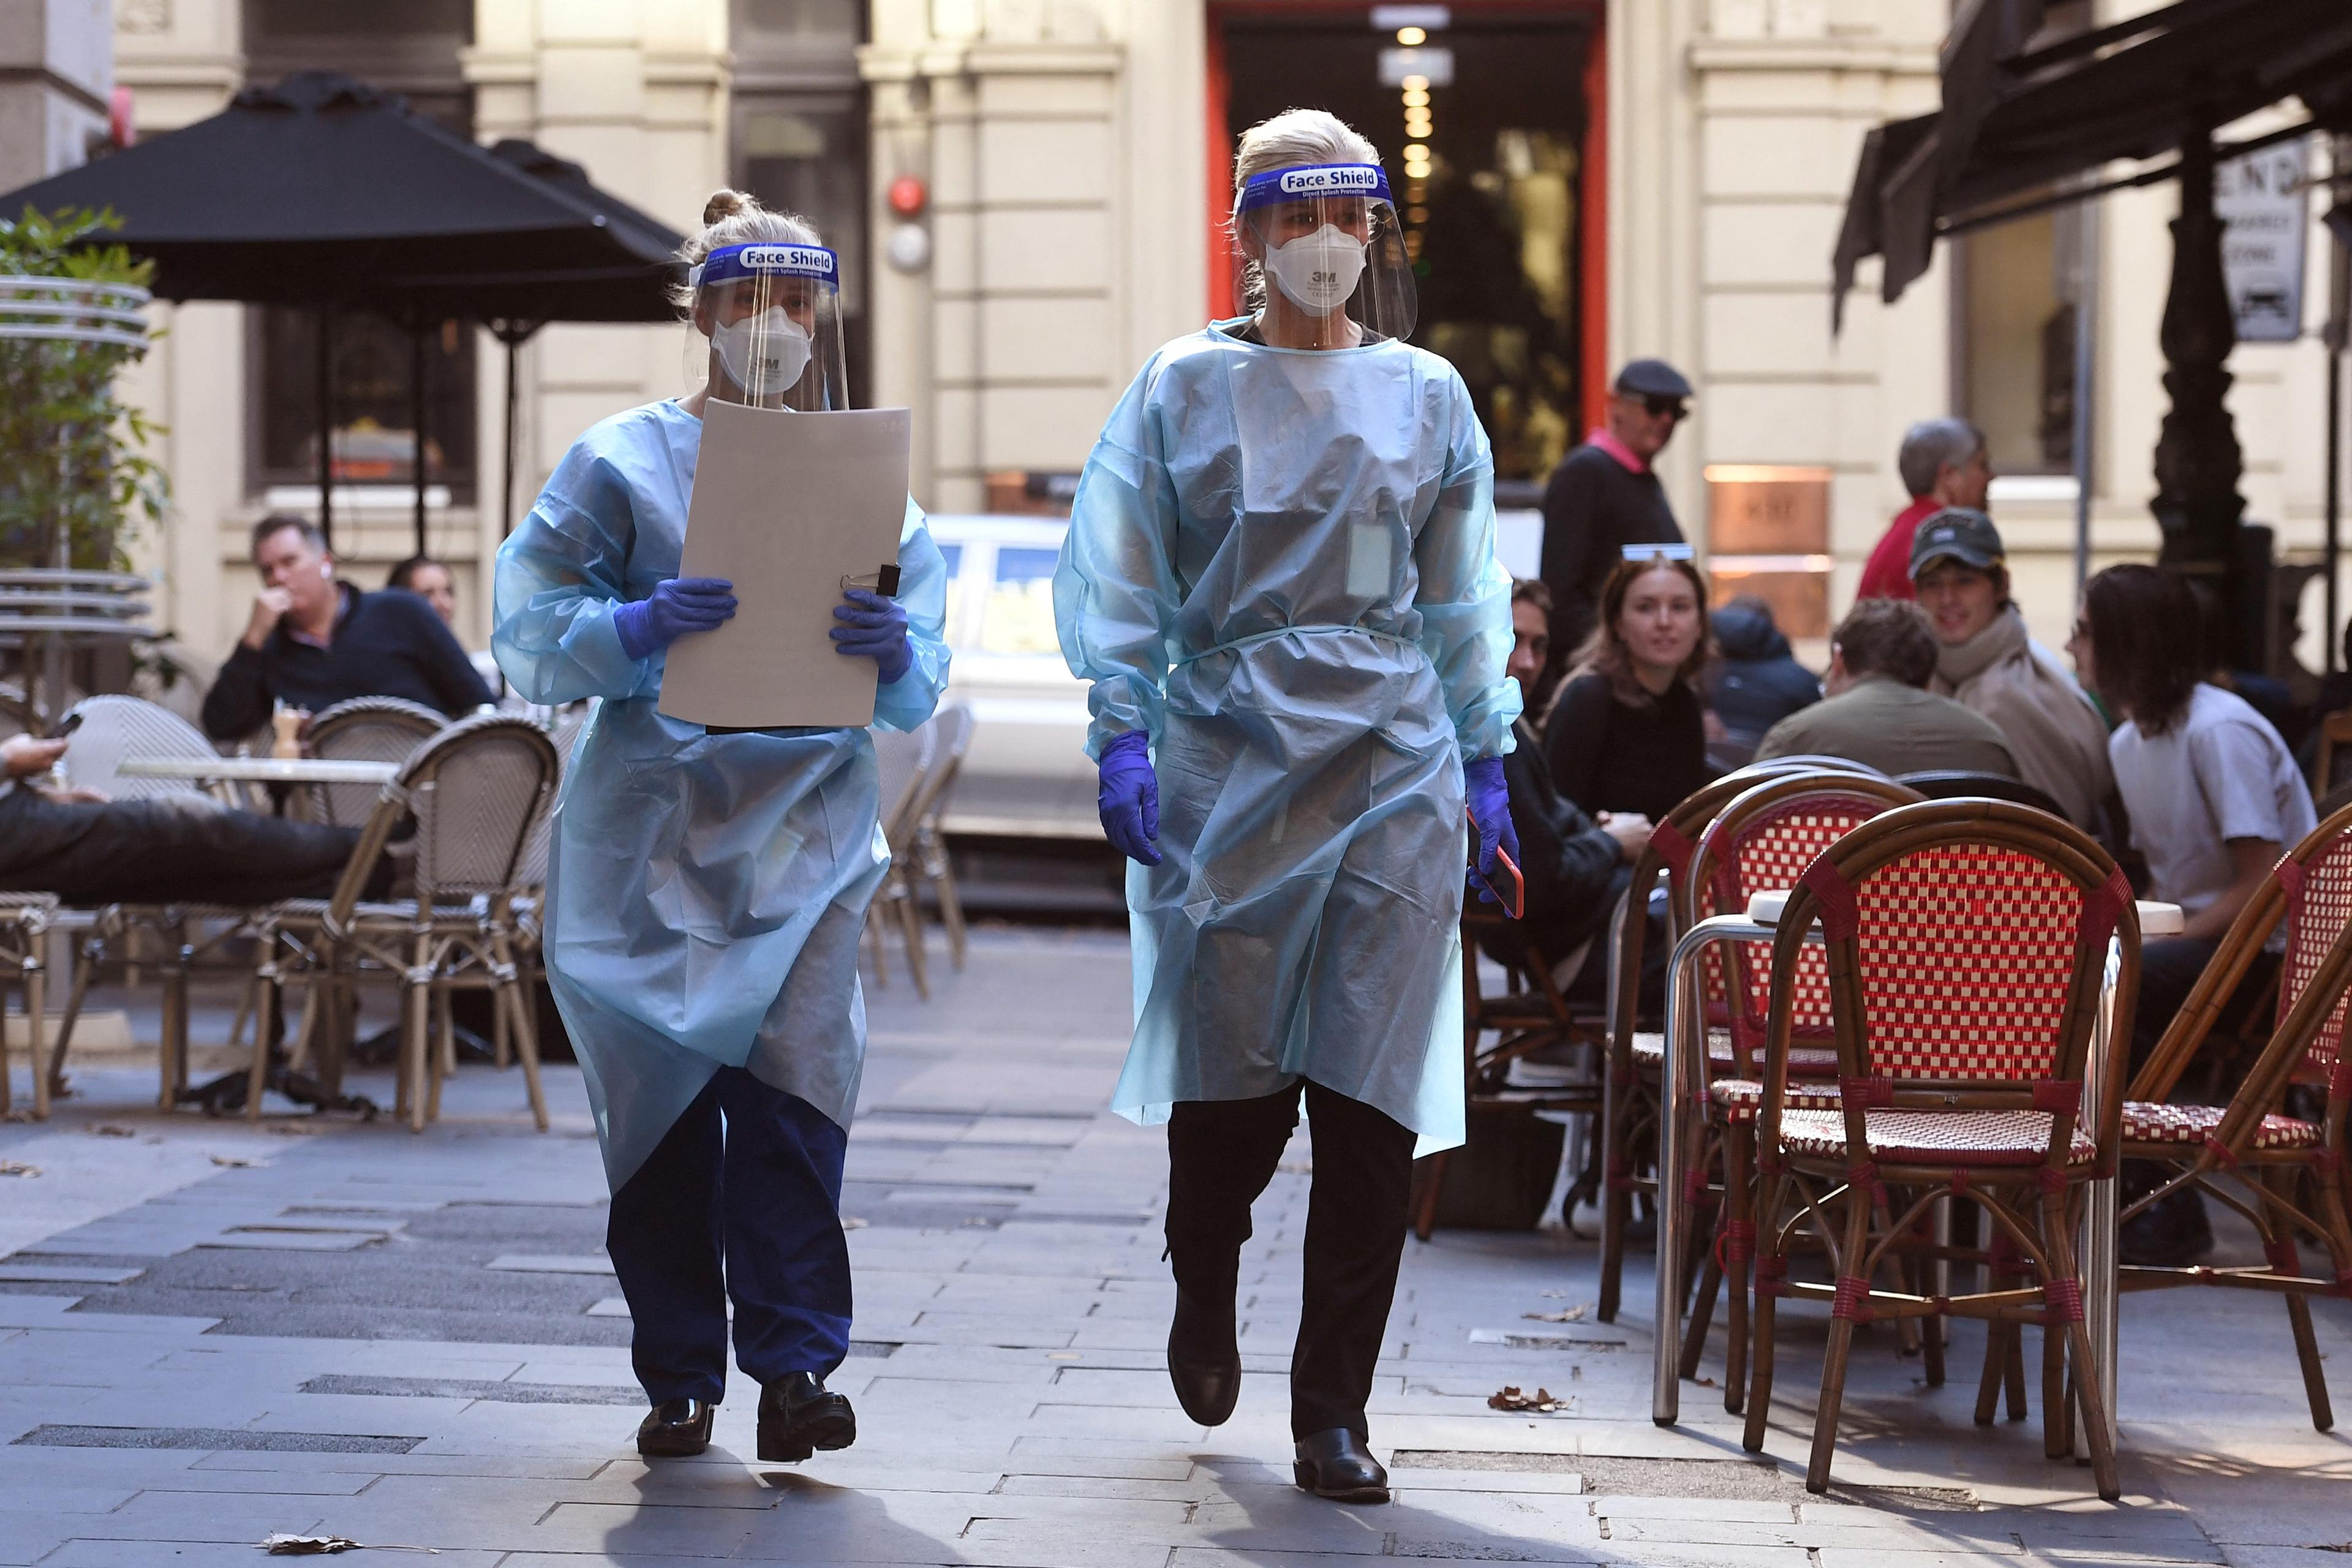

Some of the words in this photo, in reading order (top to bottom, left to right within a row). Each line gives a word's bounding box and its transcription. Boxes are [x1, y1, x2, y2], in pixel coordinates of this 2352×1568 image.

[1287, 176, 1325, 189] Face
[1330, 171, 1374, 185] Shield
[747, 251, 785, 264] Face
[790, 251, 829, 269] Shield
[1312, 271, 1336, 282] 3M
